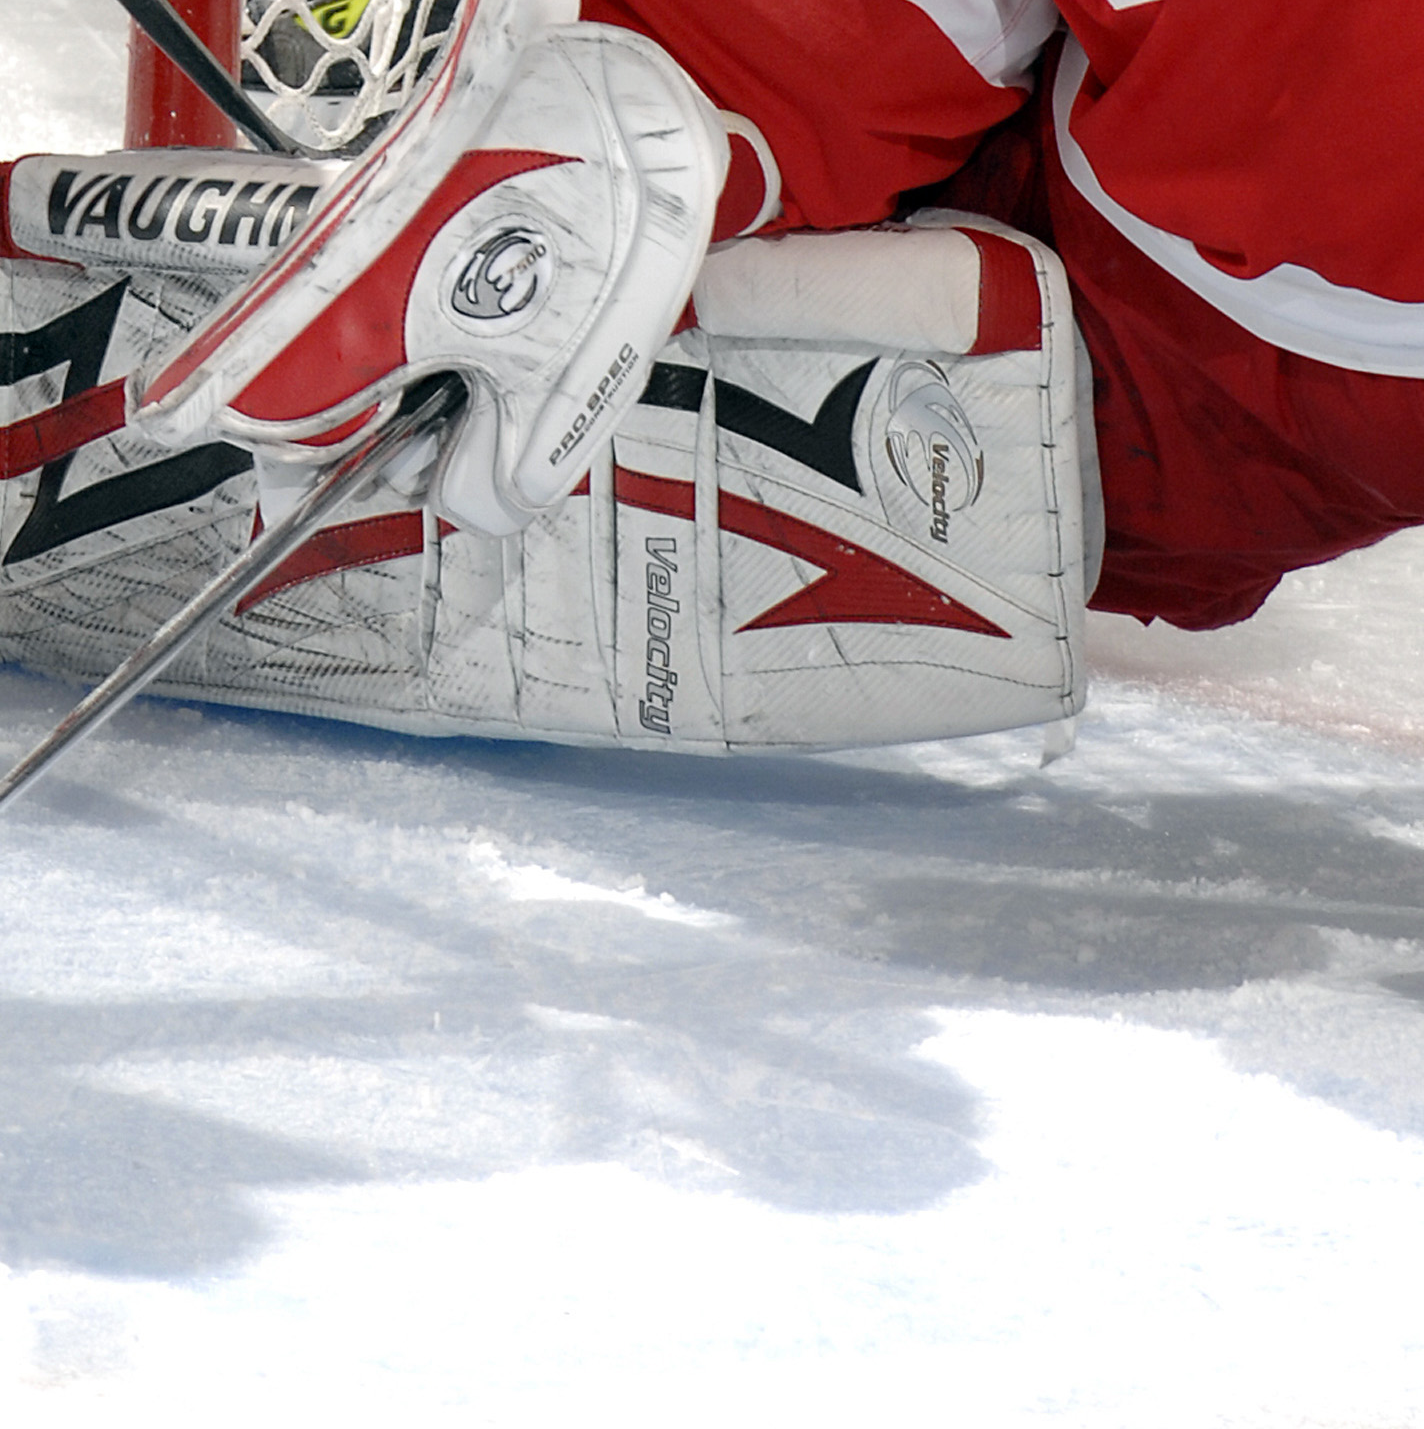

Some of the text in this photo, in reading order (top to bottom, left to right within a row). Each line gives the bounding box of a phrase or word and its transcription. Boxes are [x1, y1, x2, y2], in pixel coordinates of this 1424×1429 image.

[47, 169, 321, 247] VAUGHN
[548, 412, 588, 467] PRO
[930, 443, 949, 544] Velocity
[638, 536, 680, 735] Velocity
